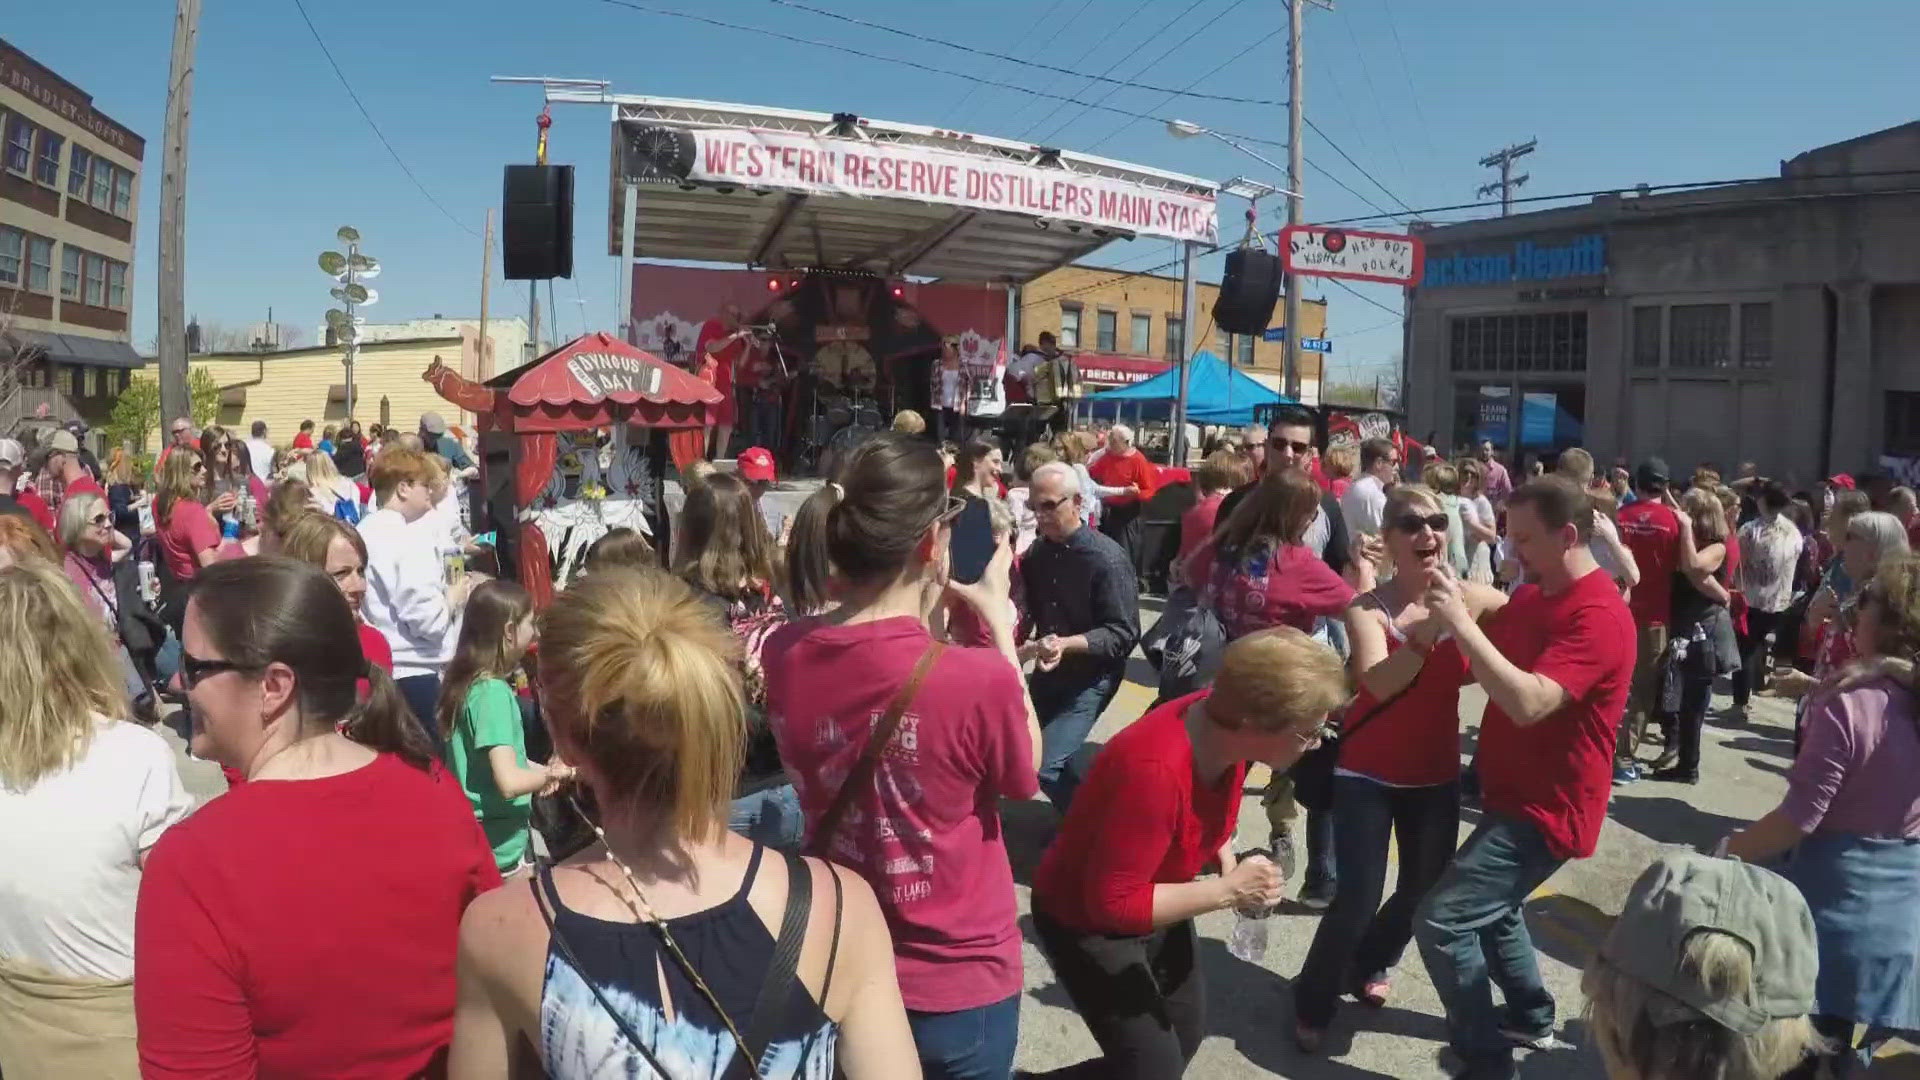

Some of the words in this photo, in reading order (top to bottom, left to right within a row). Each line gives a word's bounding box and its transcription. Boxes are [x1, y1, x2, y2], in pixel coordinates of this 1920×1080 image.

[11, 70, 78, 120] BRADLEY
[704, 138, 836, 184] WESTERN
[843, 153, 958, 198] RESERVE
[965, 169, 1093, 217] DISTILLERS
[1099, 189, 1151, 226] MAIN
[1158, 201, 1215, 237] STAGE
[1384, 240, 1408, 257] GOT
[1424, 251, 1511, 288] ackson
[1514, 234, 1606, 279] Hewitt
[578, 352, 640, 374] DYNGUS
[598, 373, 633, 392] DAY
[1087, 368, 1117, 381] BEER
